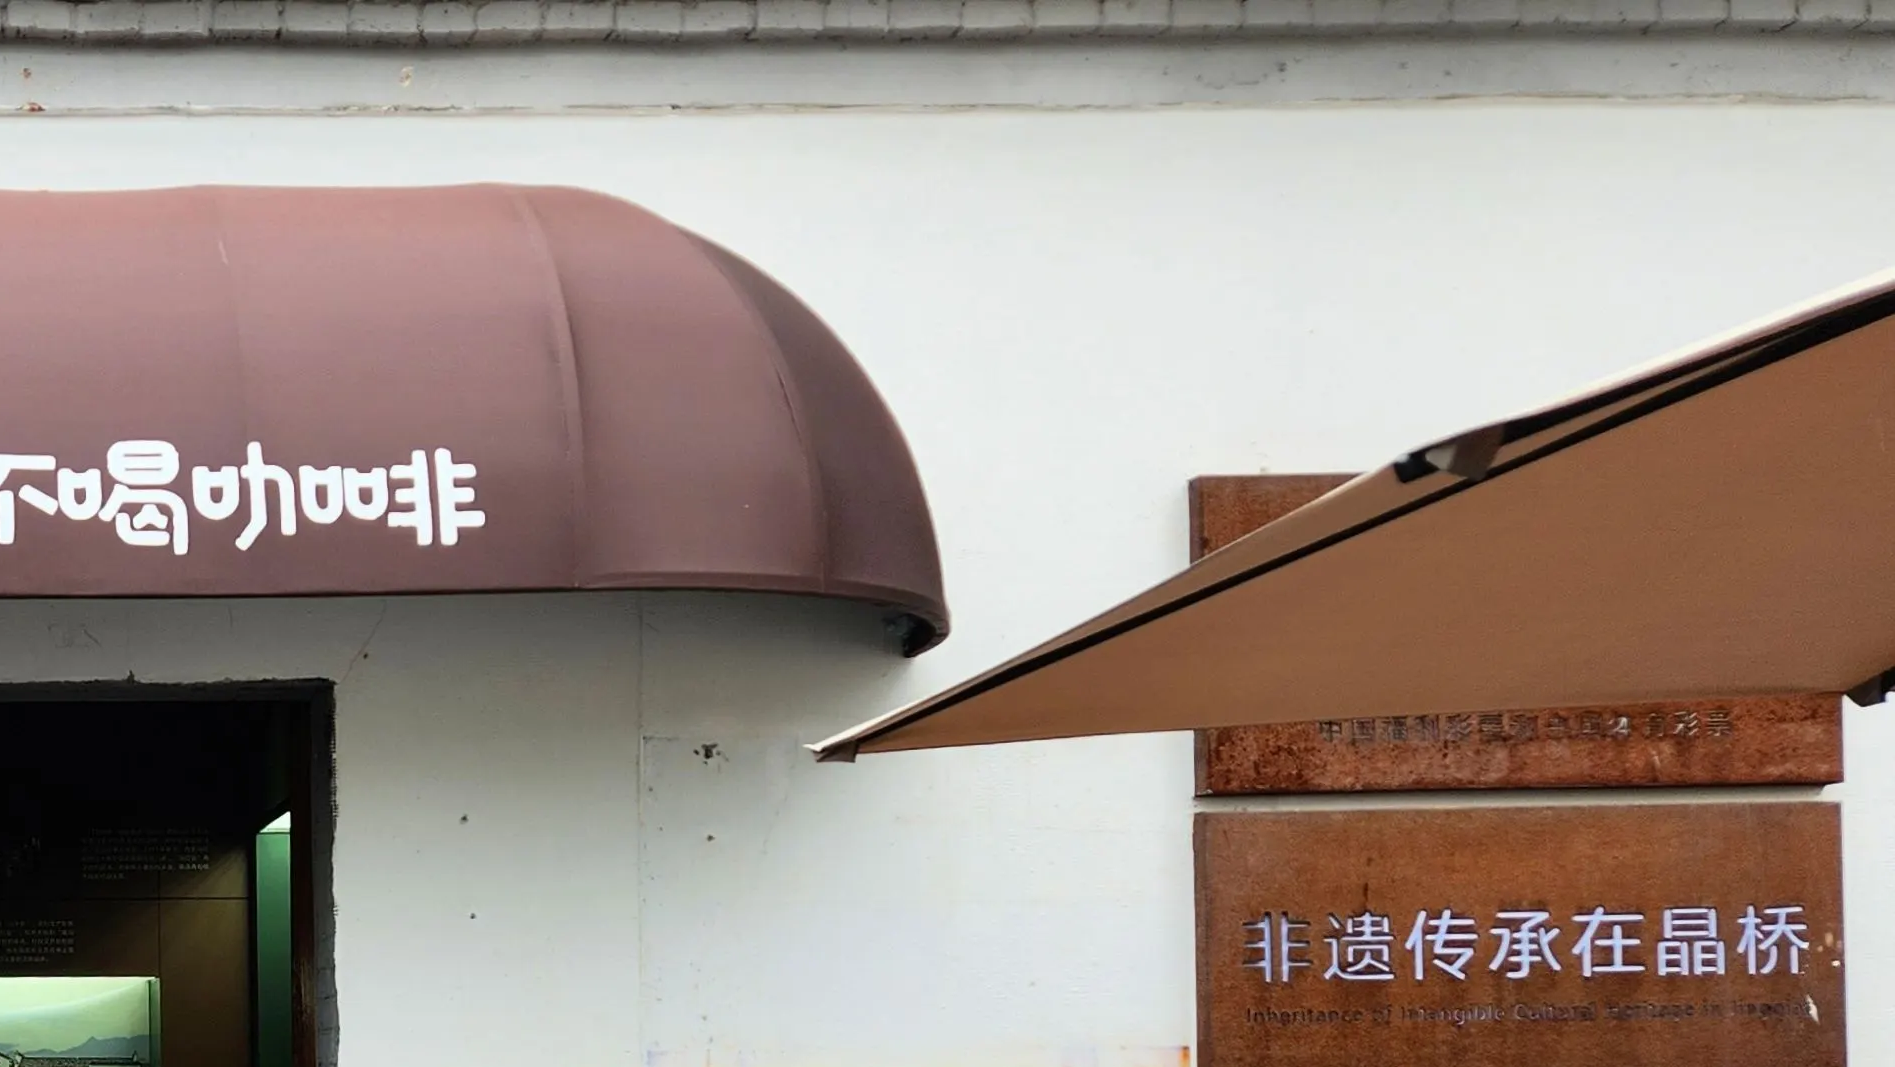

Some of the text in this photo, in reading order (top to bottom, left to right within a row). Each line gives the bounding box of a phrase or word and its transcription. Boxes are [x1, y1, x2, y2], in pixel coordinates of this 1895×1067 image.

[1242, 905, 1810, 983] 非遗传承在晶桥
[1246, 1006, 1363, 1024] Inheritance
